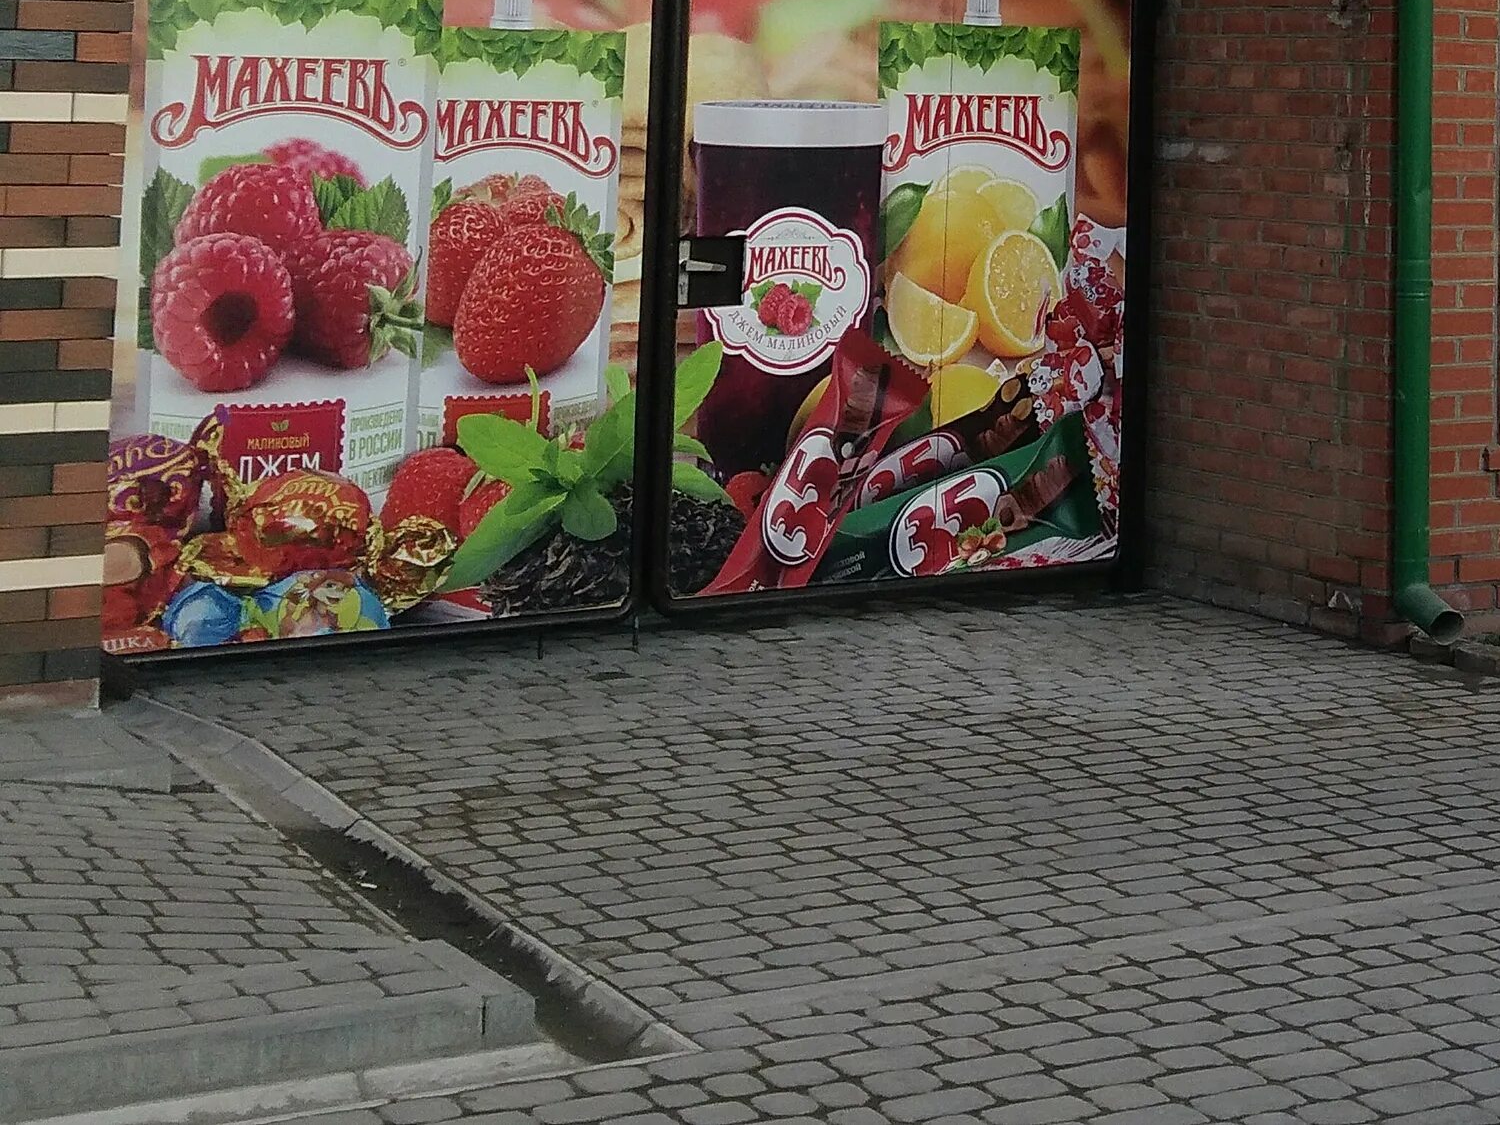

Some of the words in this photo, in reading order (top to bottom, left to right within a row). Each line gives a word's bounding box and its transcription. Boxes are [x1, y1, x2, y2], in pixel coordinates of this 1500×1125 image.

[728, 310, 763, 344] ДЖЕМ
[766, 305, 847, 351] МАЛИНОВЫЙ
[247, 432, 310, 450] МАЛИНОВЫЙ
[349, 439, 356, 460] В
[359, 428, 403, 459] РОССИИ
